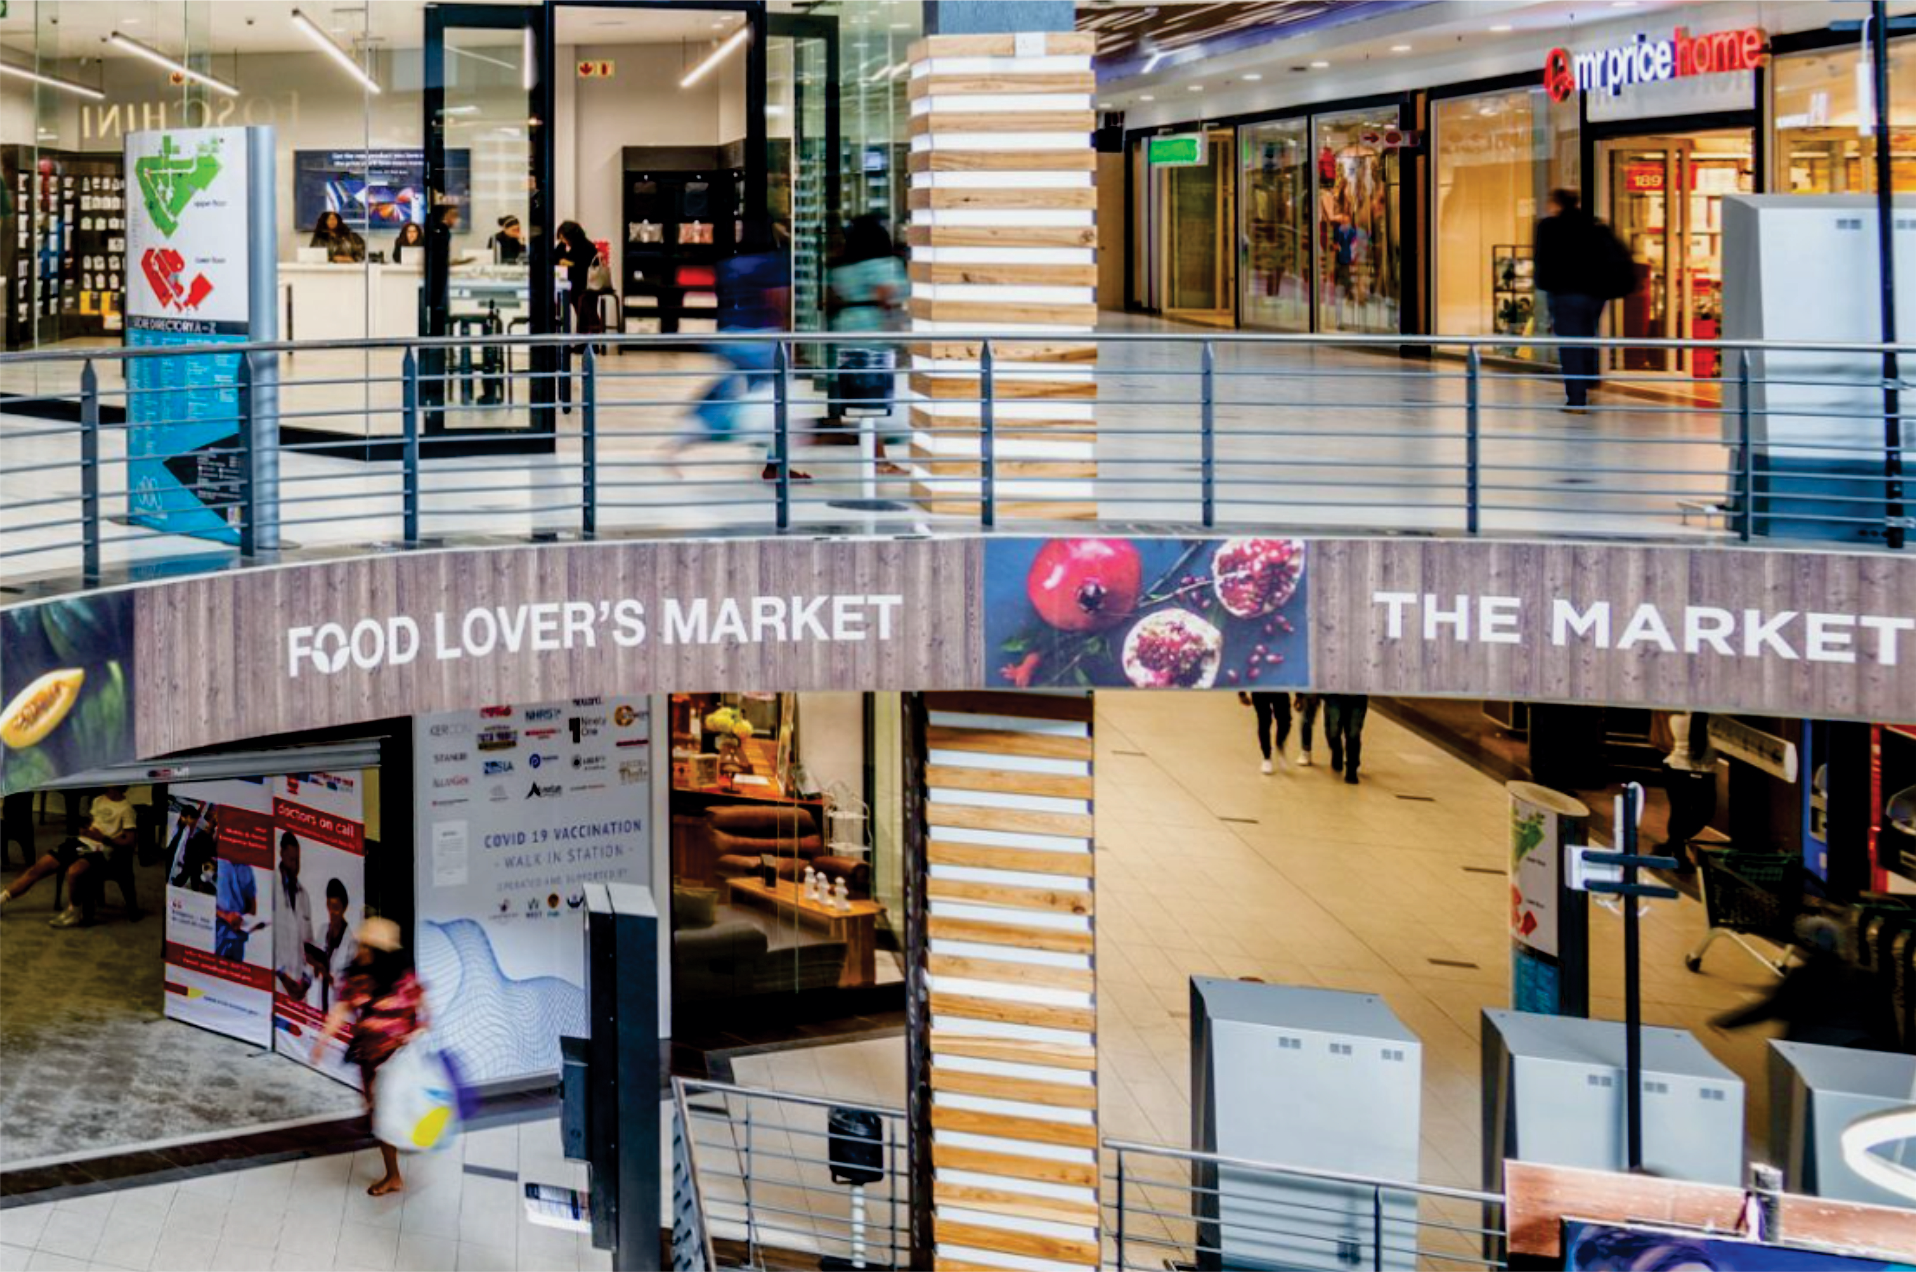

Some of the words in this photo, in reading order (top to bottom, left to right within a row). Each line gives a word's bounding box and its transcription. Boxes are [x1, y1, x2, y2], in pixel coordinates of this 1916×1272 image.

[1634, 173, 1663, 187] 189
[288, 615, 420, 677] FOOD
[664, 595, 903, 645] MARKET
[1373, 591, 1521, 643] THE
[1552, 599, 1916, 665] MARKET
[277, 802, 317, 826] doctors
[319, 818, 334, 832] on
[335, 823, 355, 839] call
[484, 831, 526, 849] COVID
[532, 829, 548, 844] 19
[553, 819, 642, 841] VACCINATION
[505, 854, 542, 869] WALK
[547, 850, 561, 864] IN
[568, 844, 624, 863] STATION
